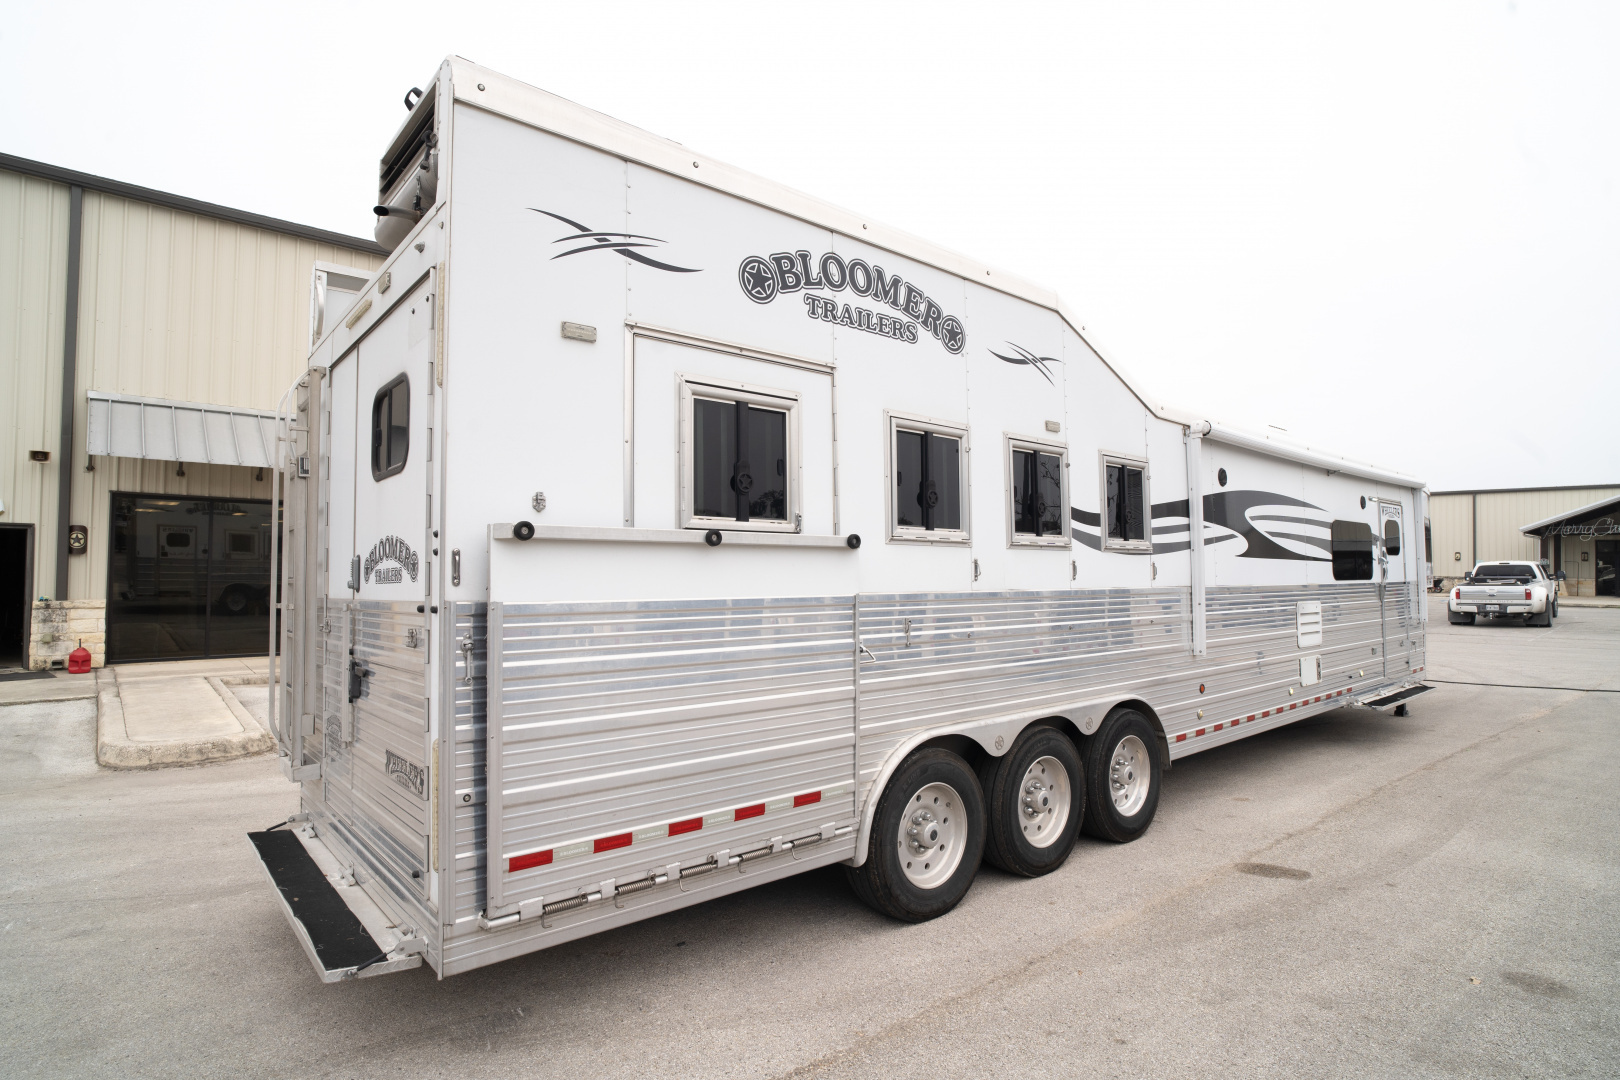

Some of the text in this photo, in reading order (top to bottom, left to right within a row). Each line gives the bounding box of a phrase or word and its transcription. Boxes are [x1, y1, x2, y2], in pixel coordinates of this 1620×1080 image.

[769, 250, 943, 340] BLOOMER
[804, 293, 918, 344] TRAILERS
[369, 535, 411, 574] BLOOMER
[375, 567, 402, 584] TRAILERS
